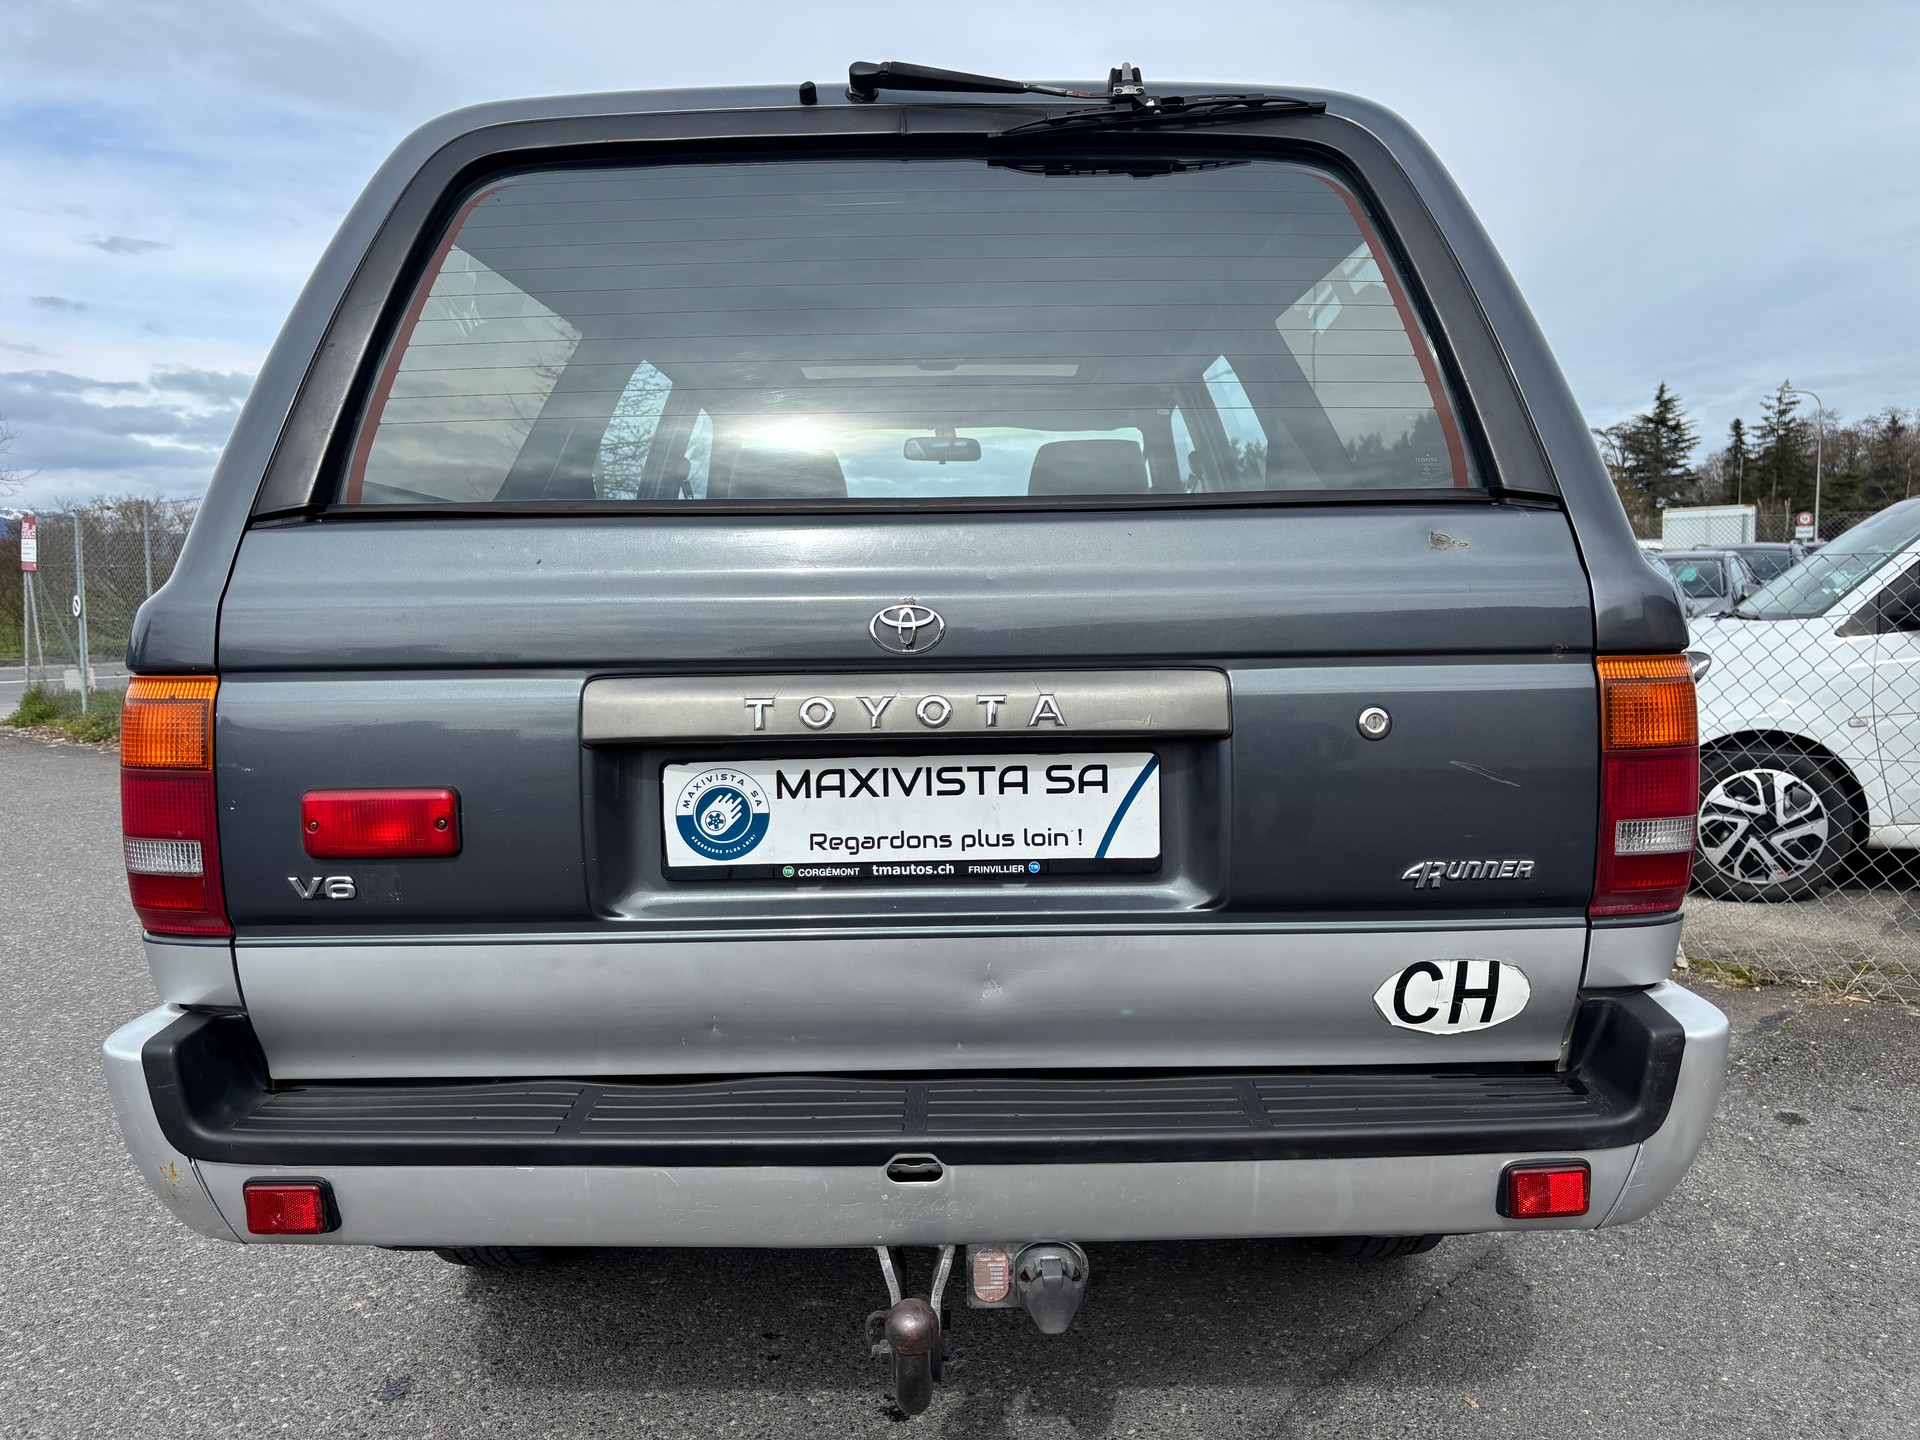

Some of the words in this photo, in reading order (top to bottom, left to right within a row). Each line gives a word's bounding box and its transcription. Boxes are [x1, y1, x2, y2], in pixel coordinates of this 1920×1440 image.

[744, 693, 1067, 731] TOYOTA
[682, 773, 745, 809] MAXIVISTA
[750, 790, 762, 806] SA
[776, 766, 1028, 799] MAXIVISTA
[1045, 764, 1108, 794] SA
[809, 830, 953, 856] Regardons
[961, 828, 1015, 851] plus
[287, 875, 357, 900] V6
[798, 866, 860, 877] CORGÉMONT
[872, 863, 955, 876] tmautos.ch
[968, 864, 1025, 874] FRINVILLIER
[1393, 960, 1500, 1024] CH
